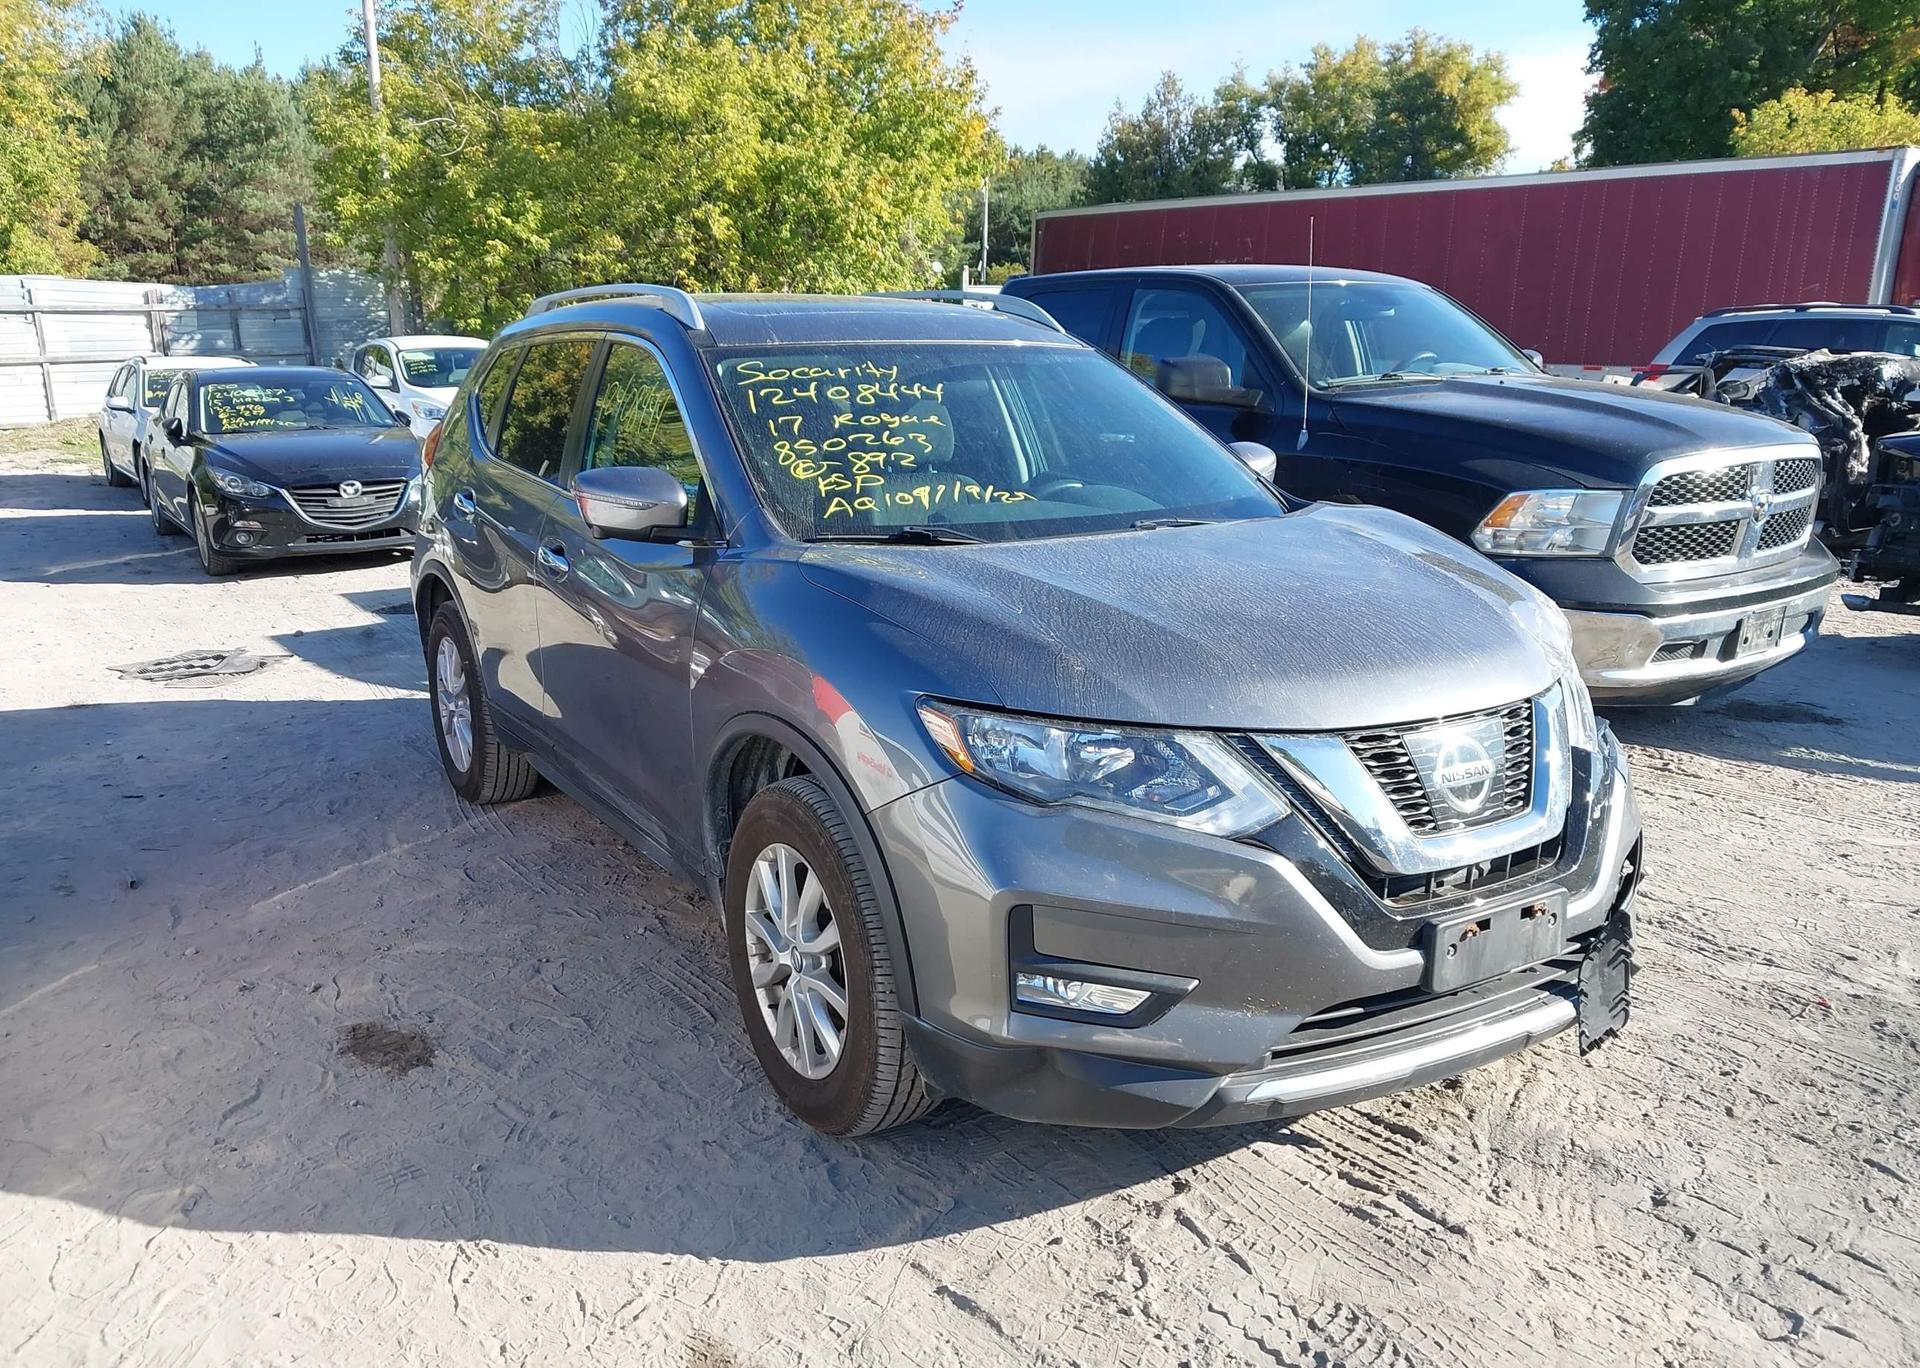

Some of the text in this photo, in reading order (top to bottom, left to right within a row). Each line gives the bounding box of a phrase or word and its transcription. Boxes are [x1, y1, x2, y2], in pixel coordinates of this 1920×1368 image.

[748, 381, 944, 414] 12408444
[768, 415, 803, 436] 17
[773, 430, 933, 465] 850263
[1441, 765, 1490, 784] NISSAN
